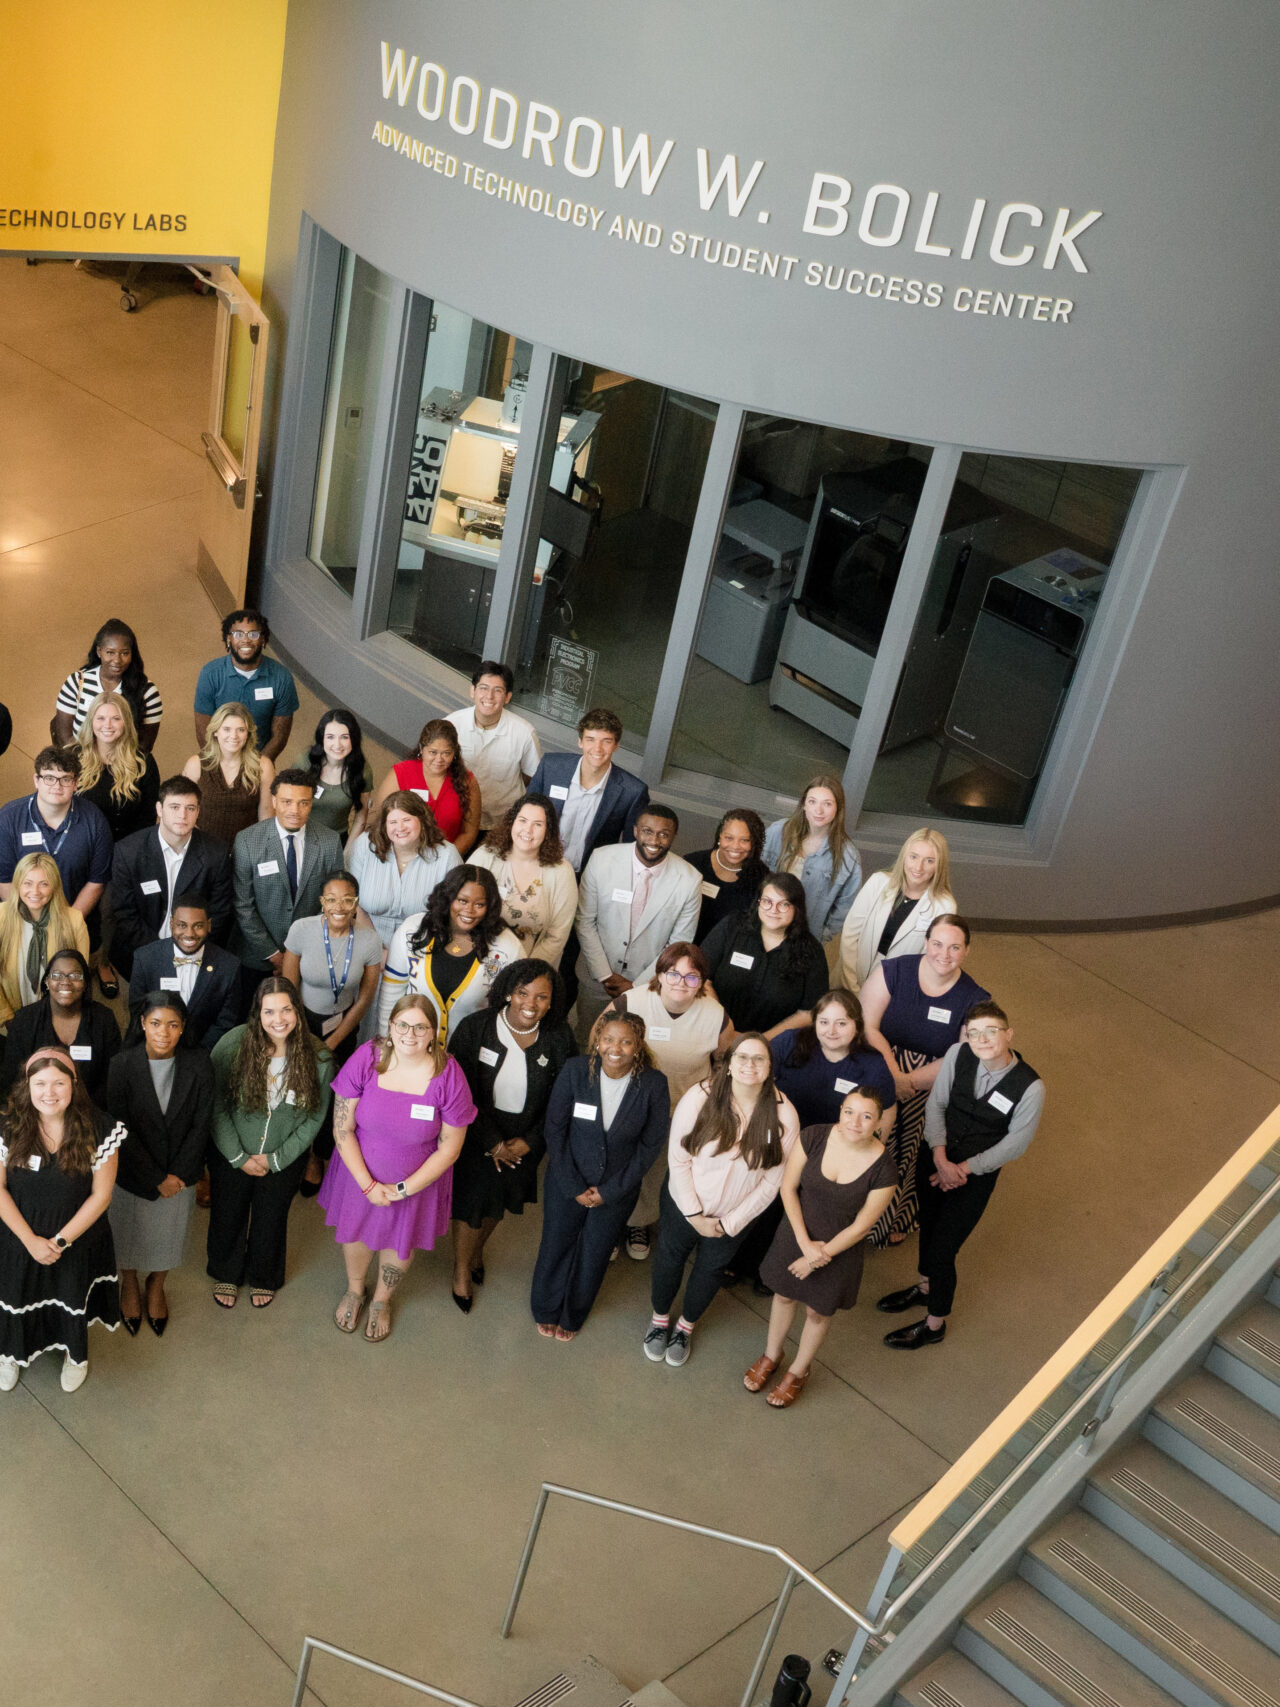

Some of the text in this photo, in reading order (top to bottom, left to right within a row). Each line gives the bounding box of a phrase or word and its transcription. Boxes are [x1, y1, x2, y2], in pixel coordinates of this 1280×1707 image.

[379, 41, 1104, 275] WOODROW W. BOLICK
[132, 213, 188, 232] LABS
[371, 120, 1075, 325] ADVANCED TECHNOLOGY AND STUDENT SUCCESS CENTER
[551, 671, 582, 695] PVCC
